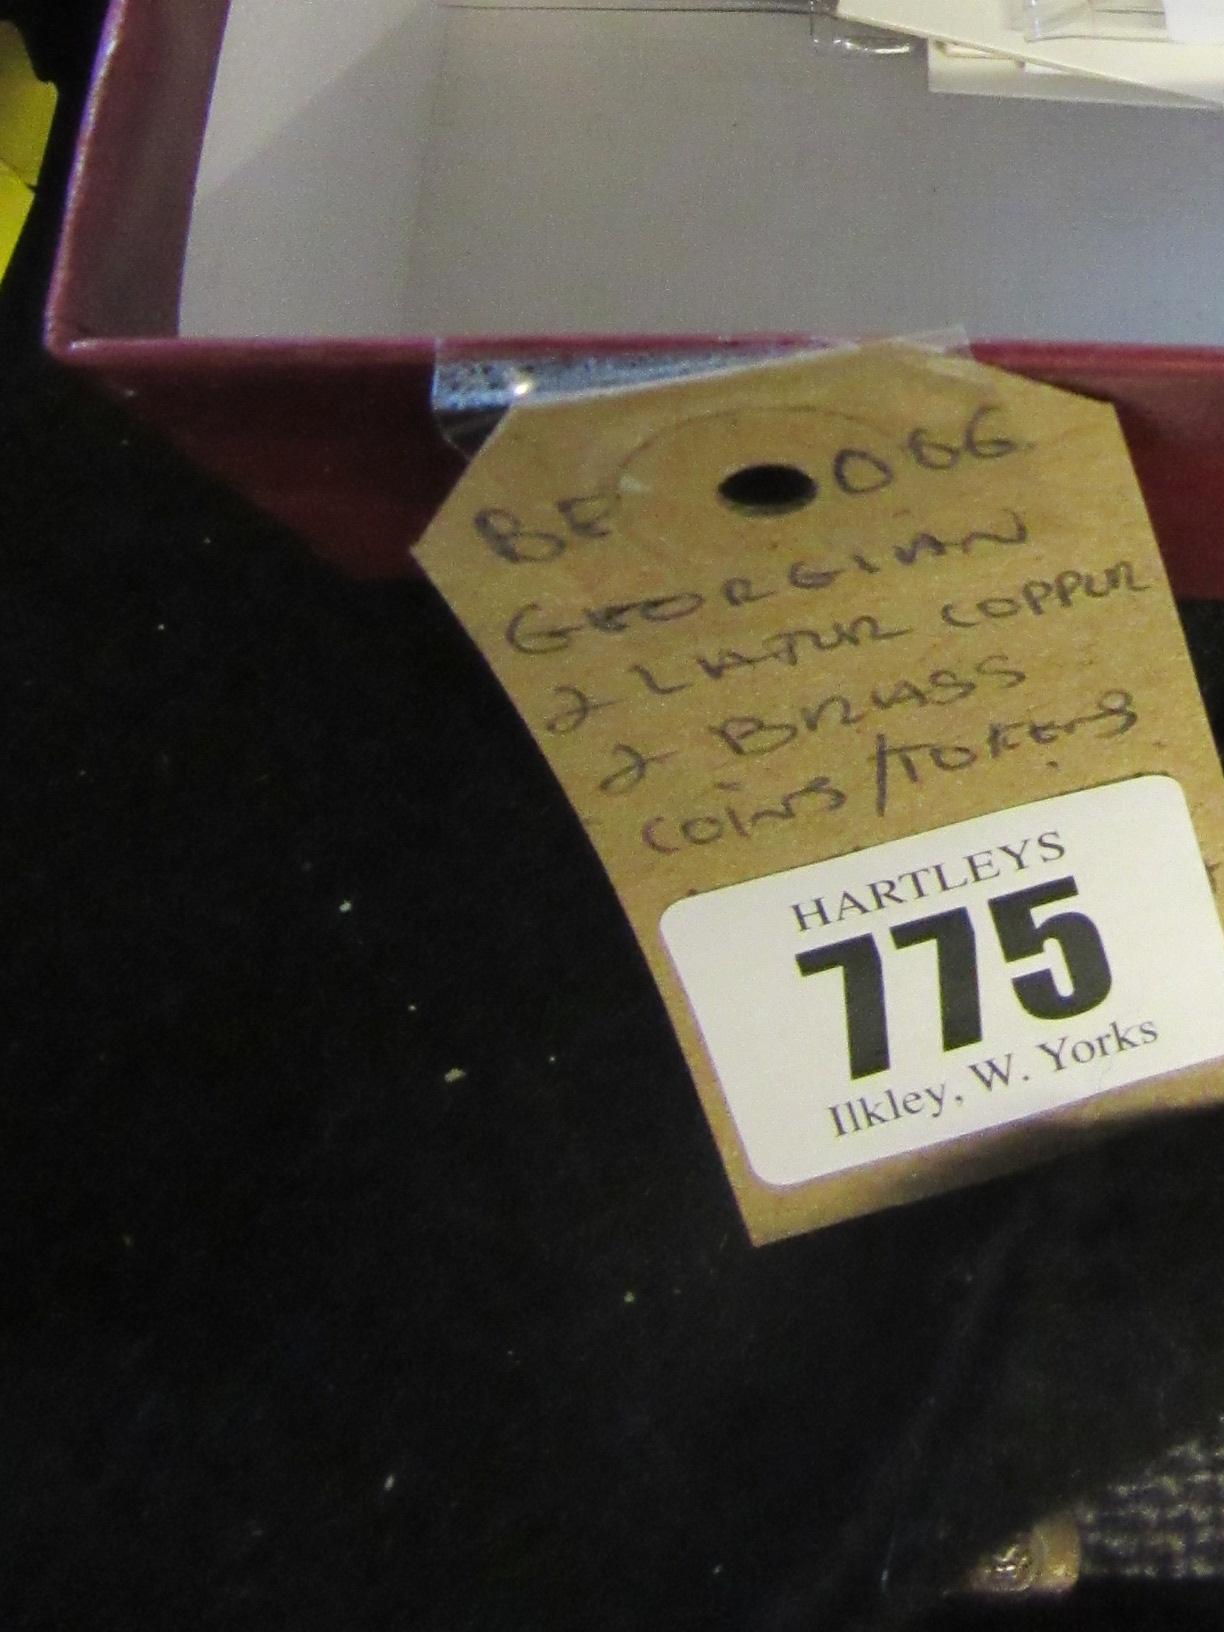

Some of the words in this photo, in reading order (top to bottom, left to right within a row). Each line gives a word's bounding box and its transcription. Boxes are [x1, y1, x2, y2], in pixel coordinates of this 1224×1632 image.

[504, 505, 1030, 656] GEORGIAN
[790, 830, 1067, 932] HARTLEYS
[793, 874, 1115, 1081] 775
[967, 1057, 1033, 1093] W.
[1036, 1017, 1161, 1072] Yorks
